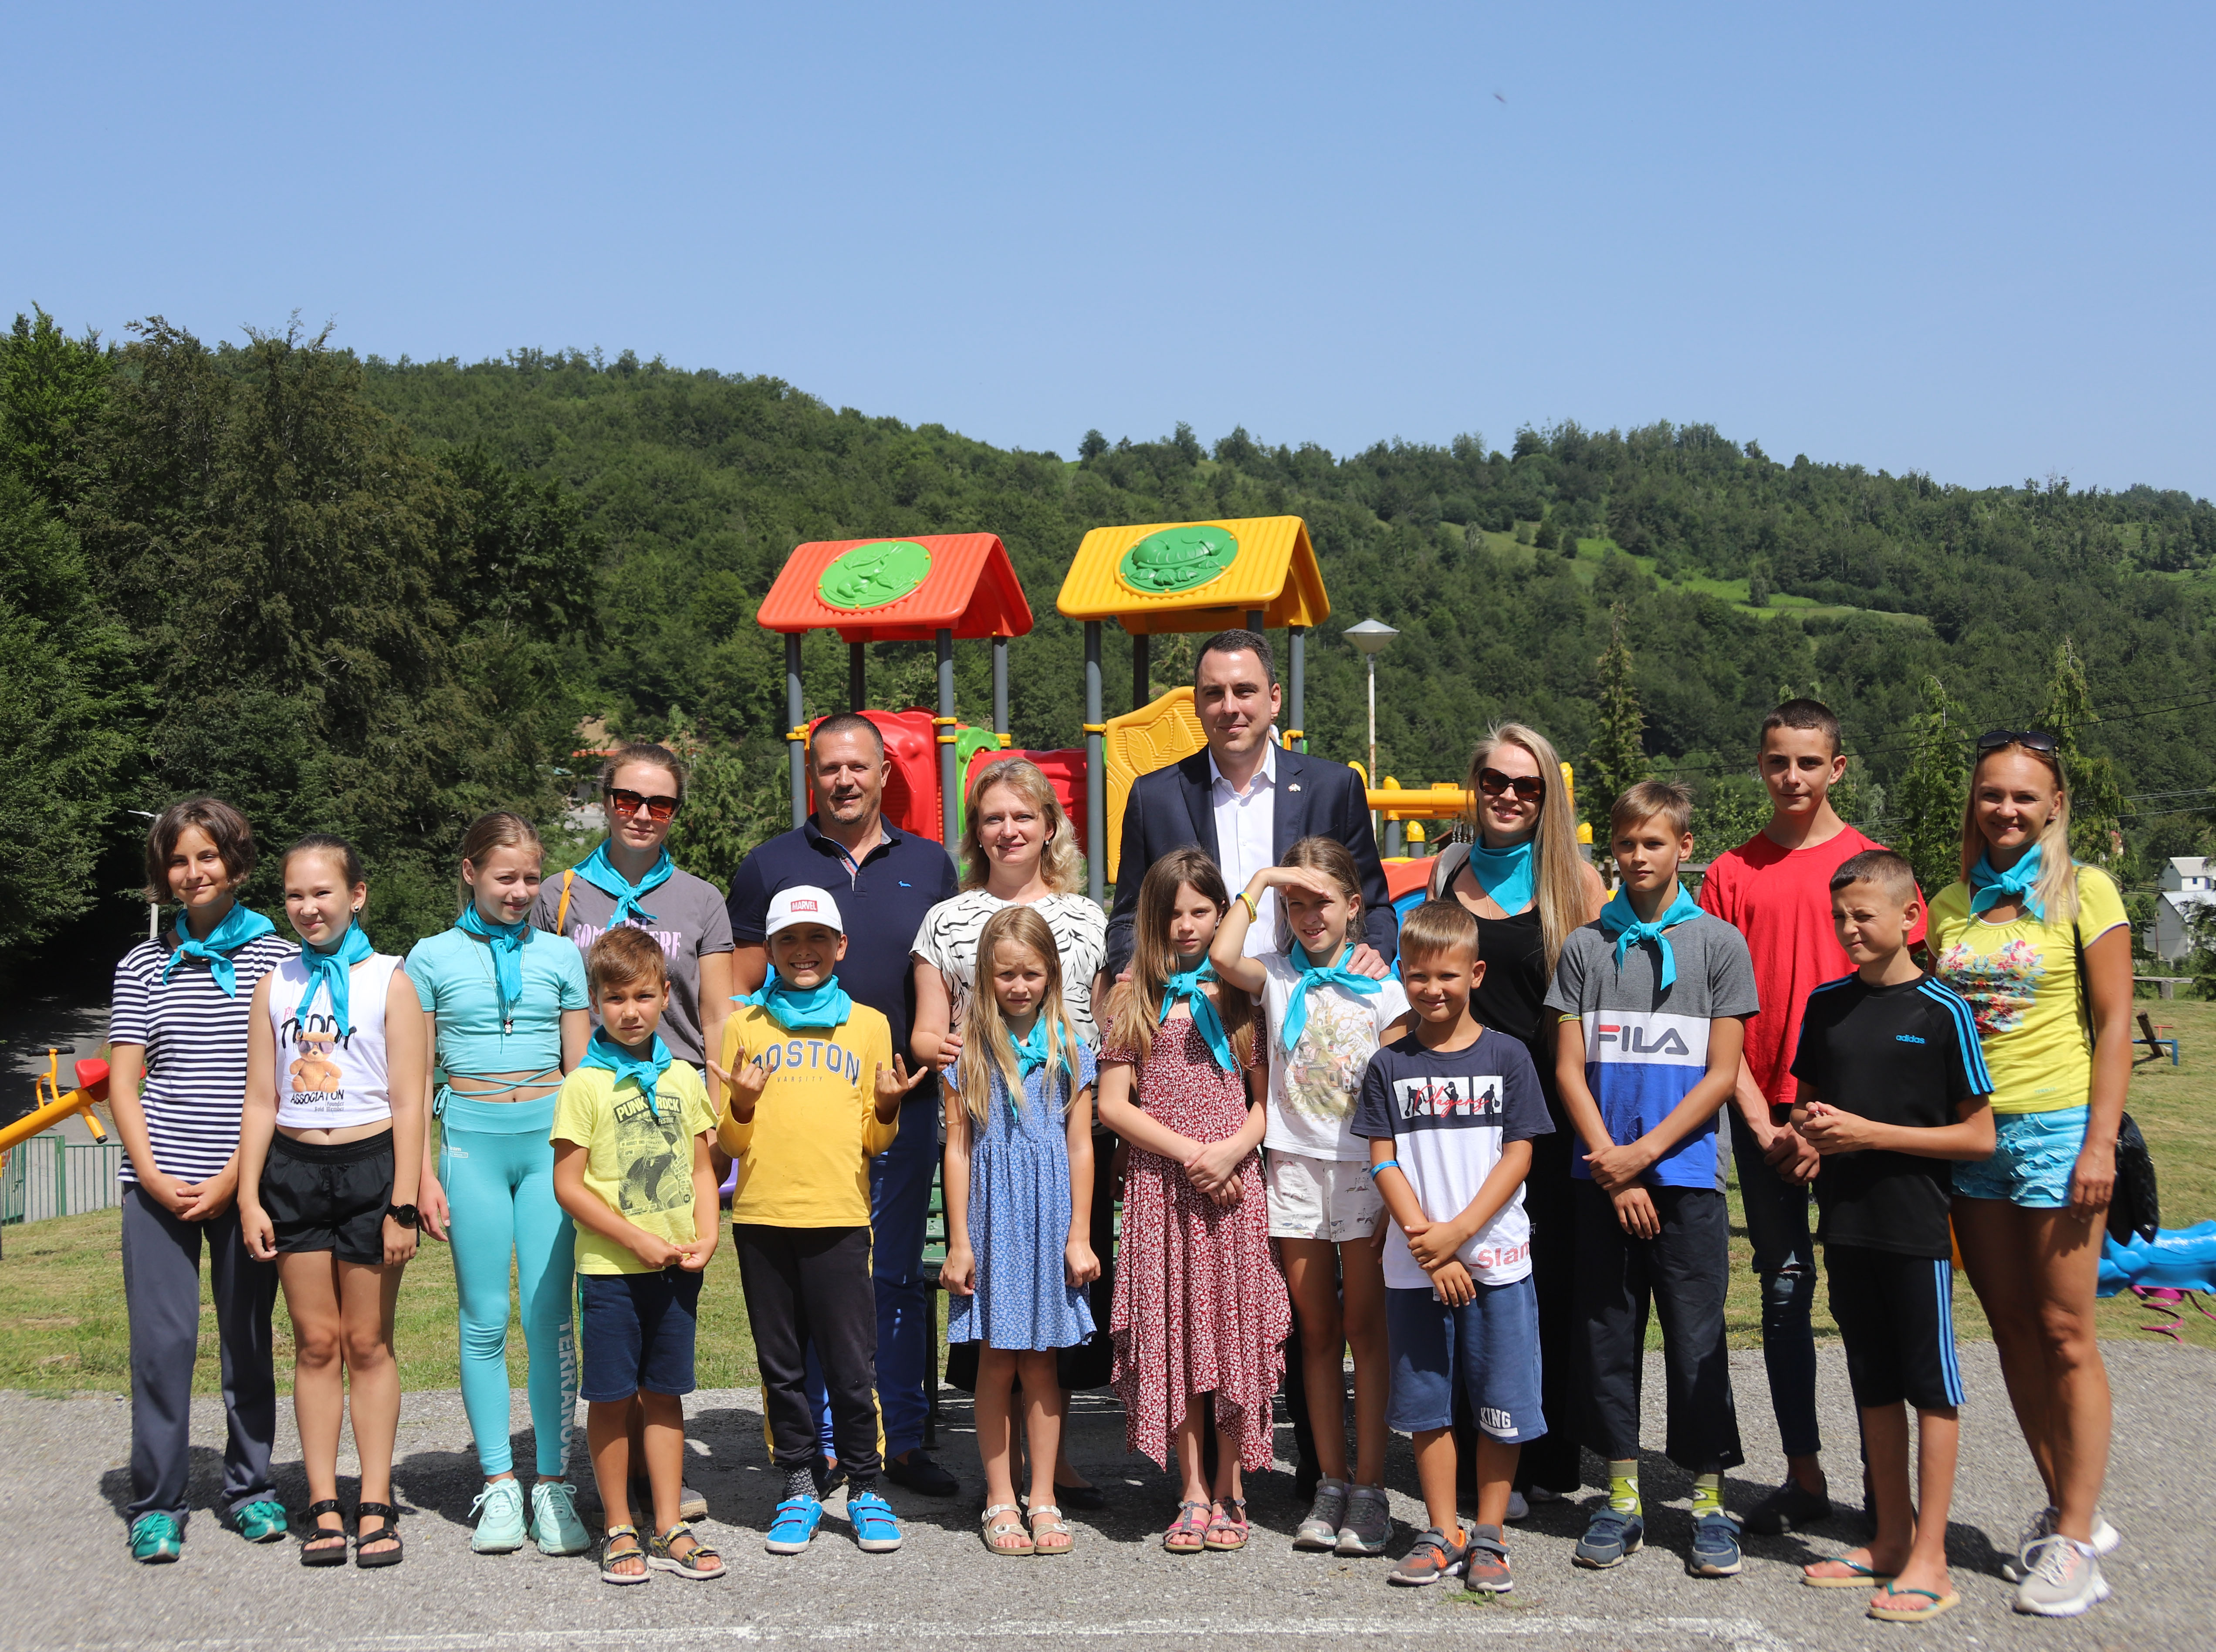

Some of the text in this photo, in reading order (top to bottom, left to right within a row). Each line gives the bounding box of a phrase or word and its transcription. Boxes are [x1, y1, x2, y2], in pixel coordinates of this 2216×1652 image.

[792, 901, 817, 911] MARVEL
[1598, 1024, 1689, 1055] FILA
[1896, 1034, 1925, 1044] adidas
[616, 1096, 680, 1122] PUNK ROCK
[558, 1315, 577, 1476] TERRANOVA
[1481, 1407, 1511, 1429] KING
